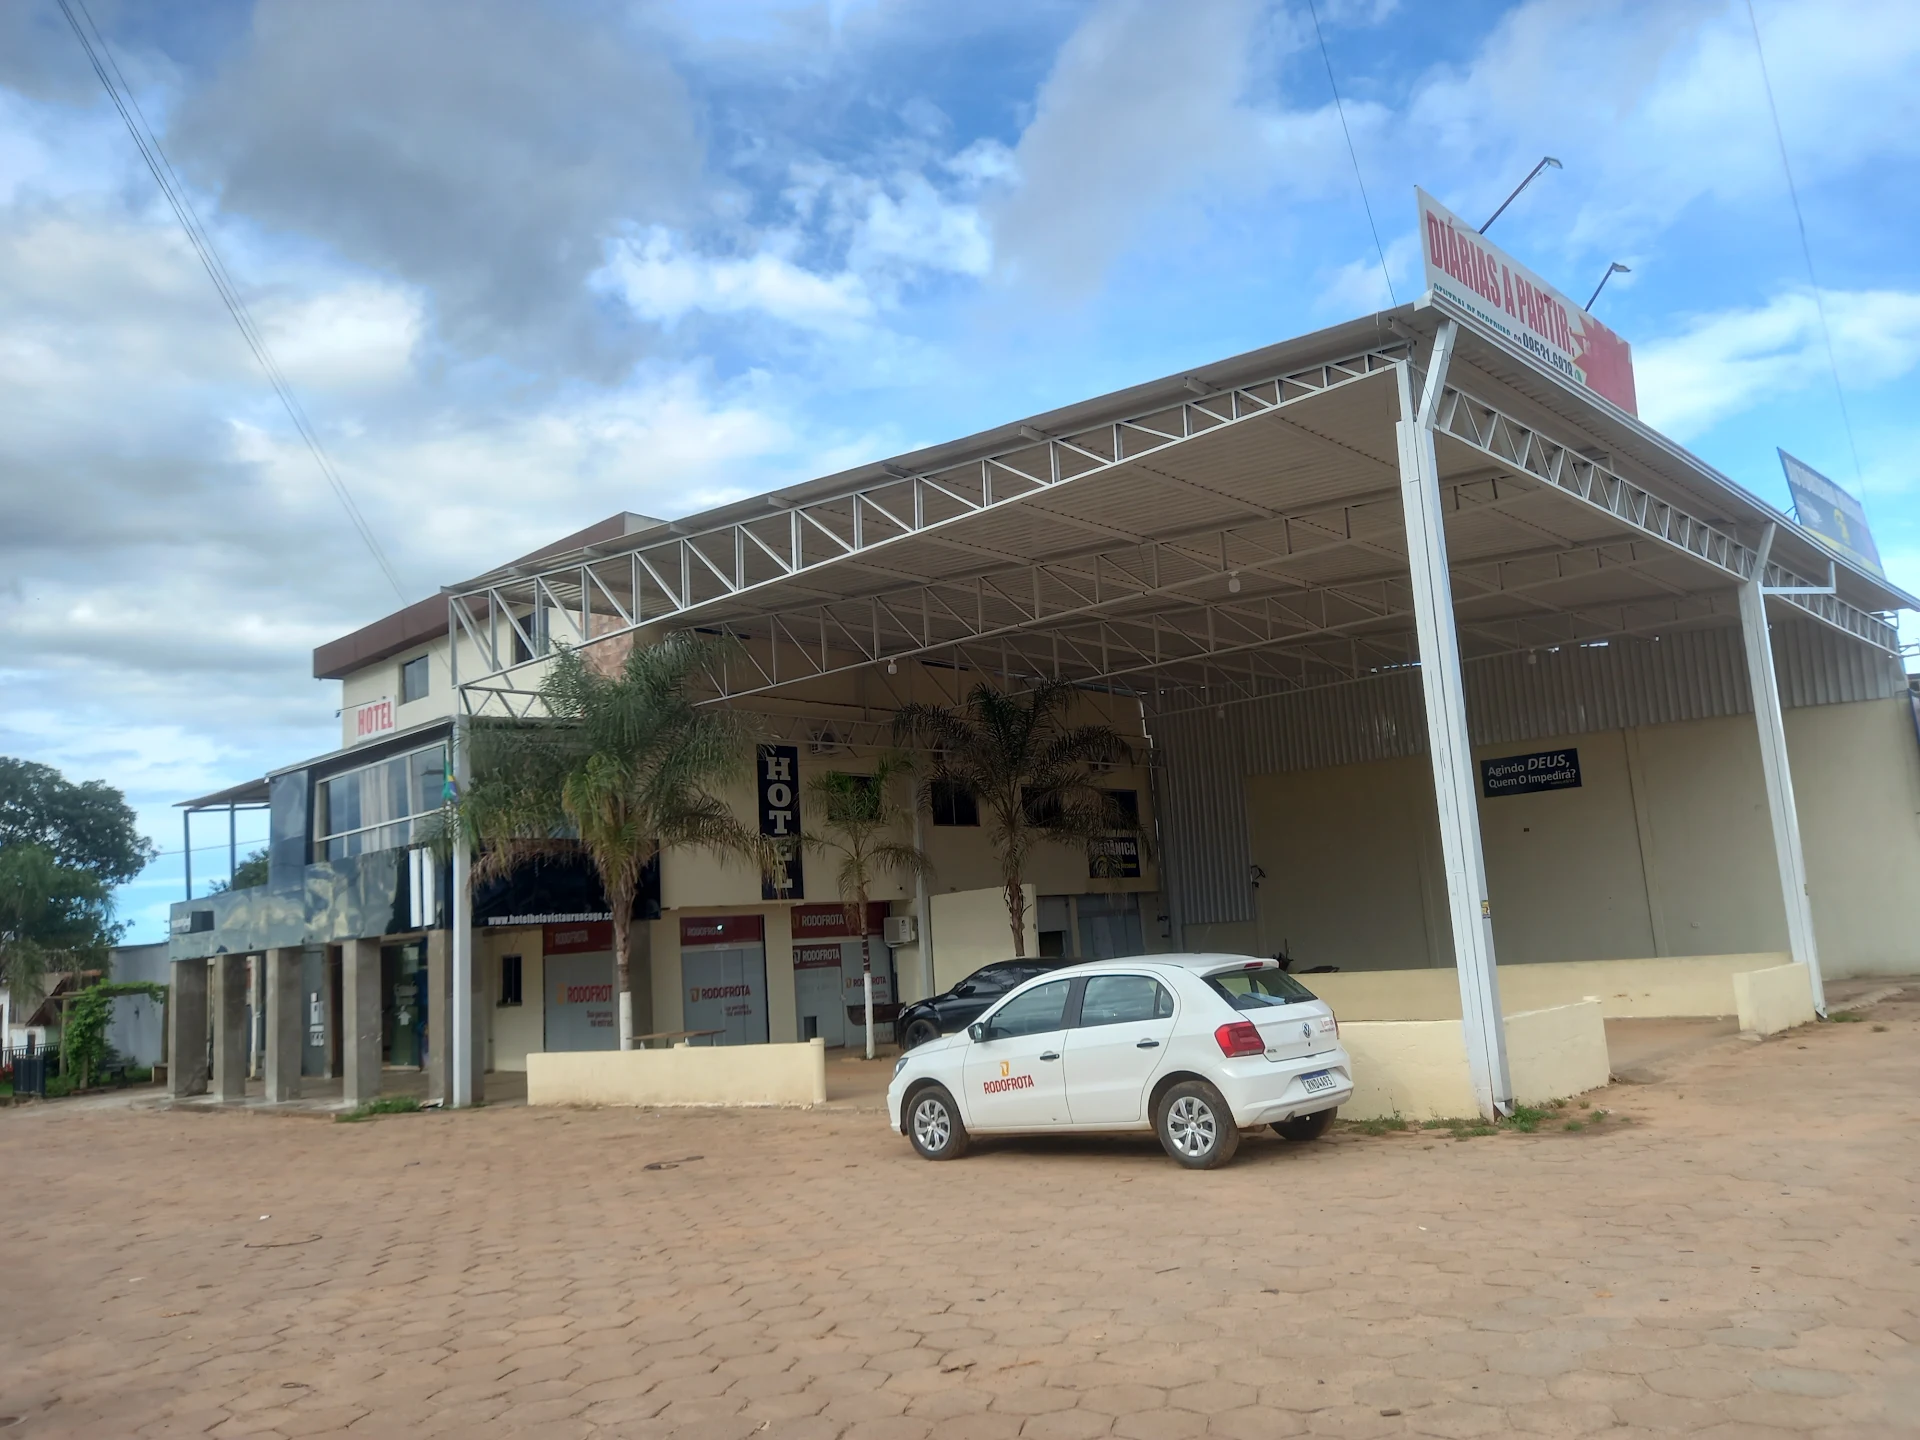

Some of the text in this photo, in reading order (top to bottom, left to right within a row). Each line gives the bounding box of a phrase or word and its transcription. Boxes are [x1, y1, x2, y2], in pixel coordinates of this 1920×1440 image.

[1426, 209, 1575, 357] DIÁRIAS A PARTIR:
[358, 701, 393, 736] HOTEL
[1488, 754, 1570, 777] Agindo DEUS,
[1489, 778, 1517, 789] Quem
[1518, 775, 1527, 784] O
[1528, 768, 1576, 784] Impedirá?
[802, 914, 845, 927] RODOFROTA
[802, 948, 840, 961] RODOFROTA
[568, 984, 612, 1002] RODOFROT
[702, 985, 750, 1000] RODOFROTA
[983, 1074, 1034, 1094] RODOFROTA
